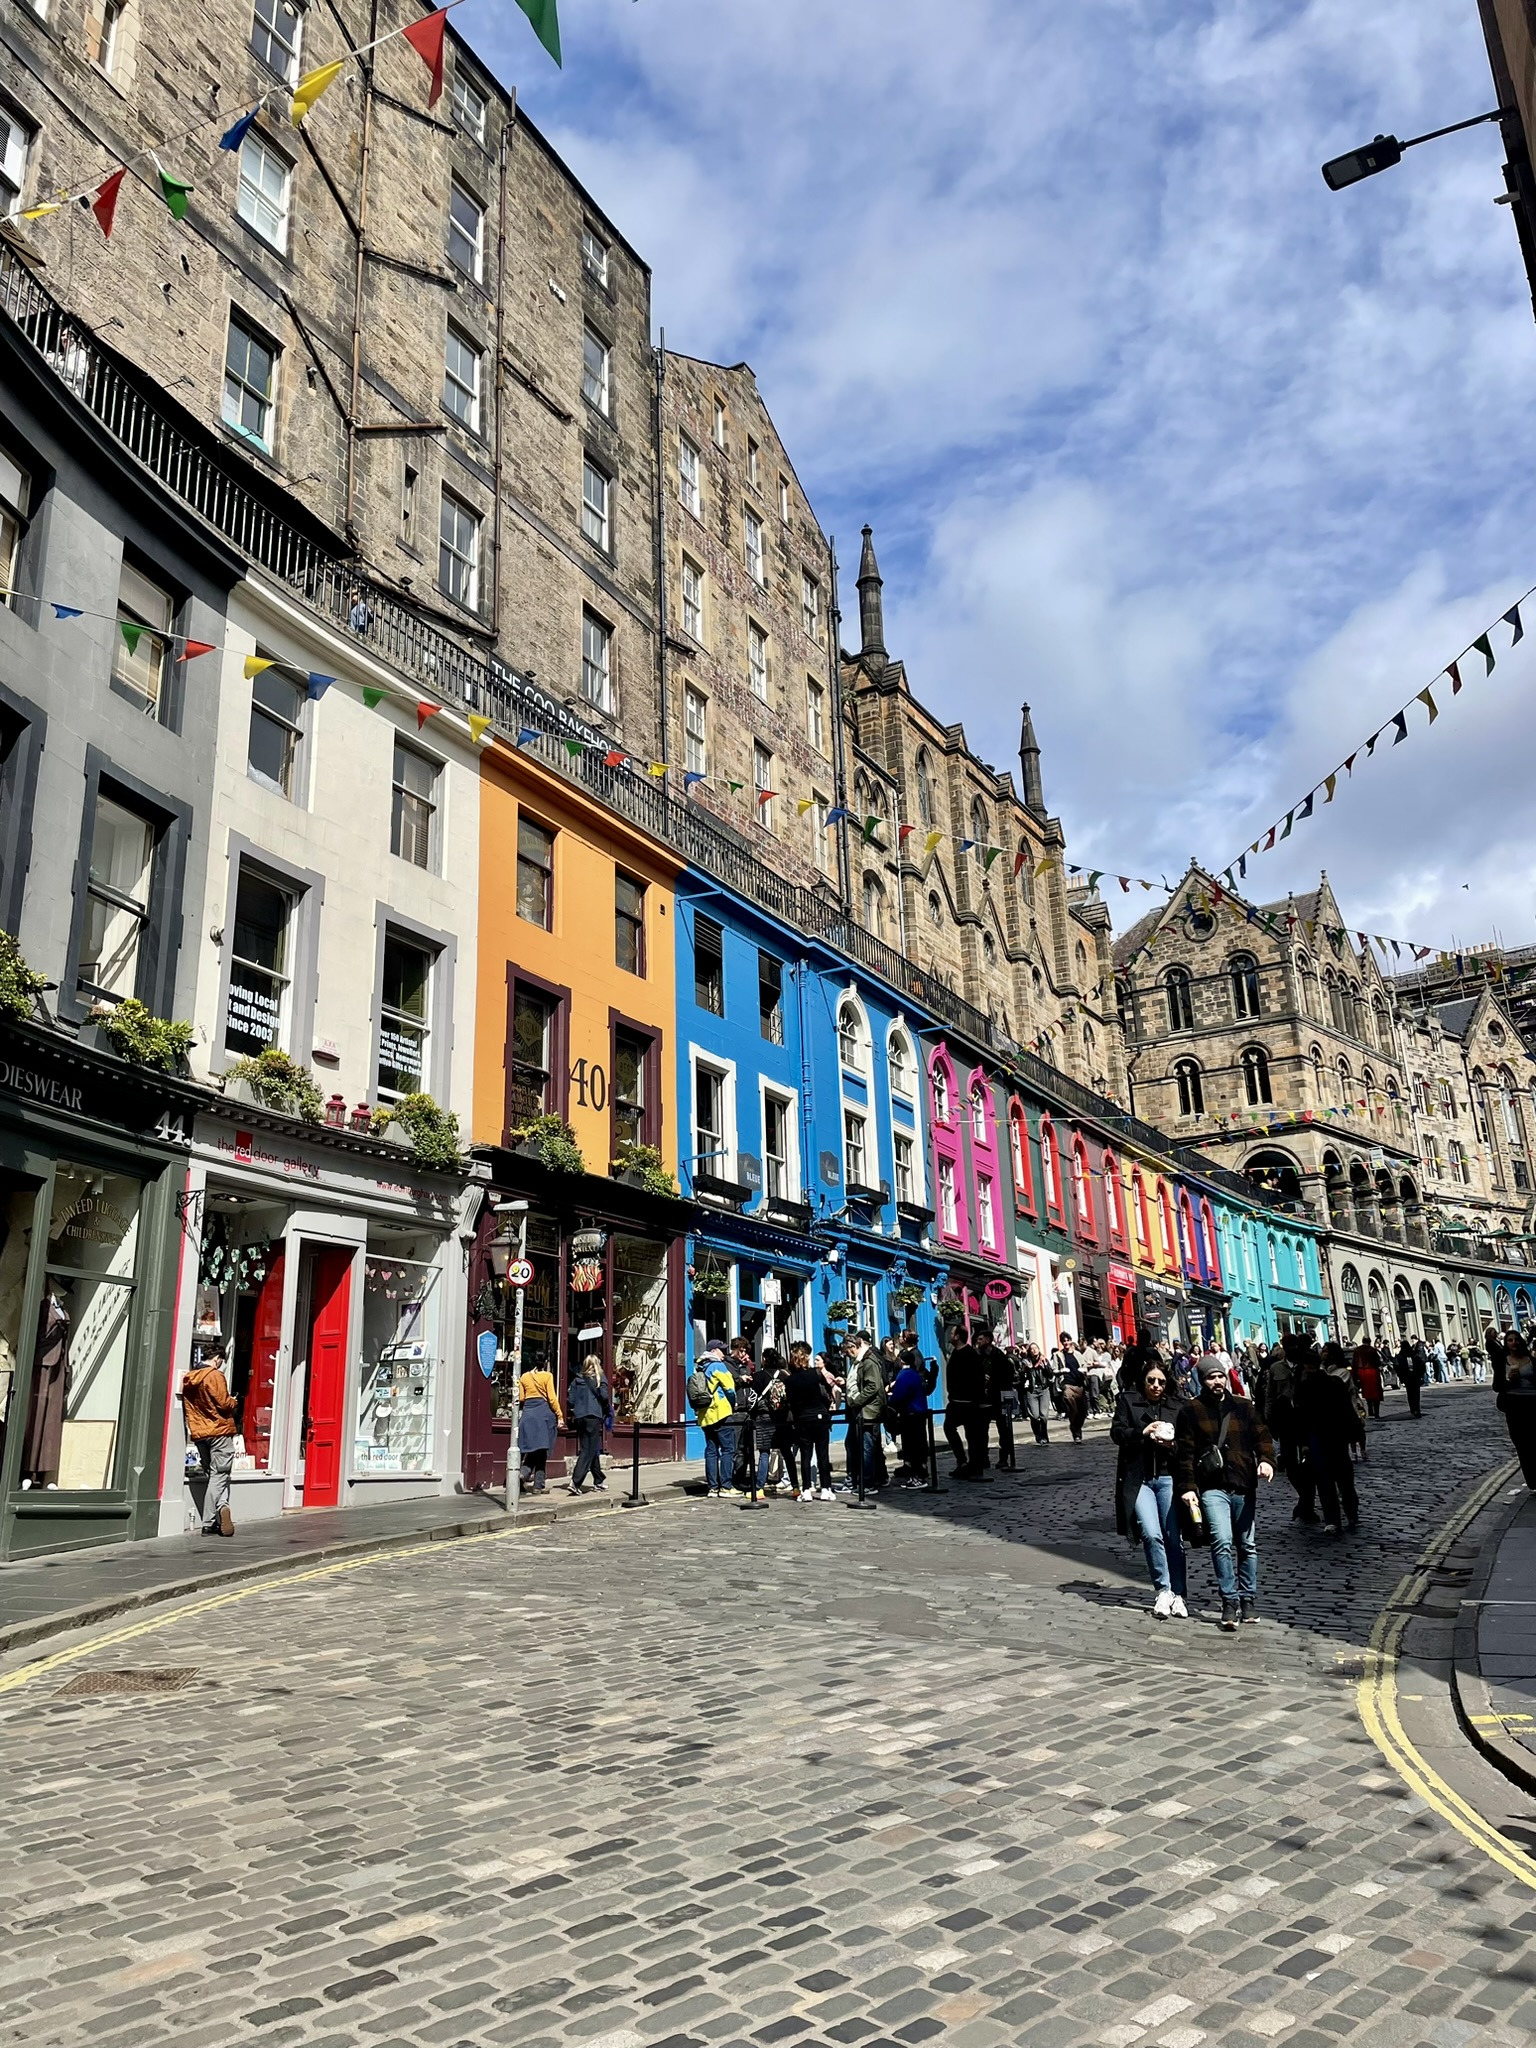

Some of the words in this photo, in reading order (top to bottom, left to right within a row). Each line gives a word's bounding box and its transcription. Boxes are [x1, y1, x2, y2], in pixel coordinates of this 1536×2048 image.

[559, 709, 632, 775] BAKEHOE
[254, 991, 278, 1012] Local
[232, 1001, 250, 1018] and
[250, 1006, 281, 1028] Design
[227, 1014, 249, 1034] ince
[249, 1022, 273, 1042] 2003
[569, 1058, 606, 1112] 40
[217, 1136, 234, 1154] the
[235, 1143, 252, 1159] red
[253, 1146, 279, 1164] door
[283, 1155, 320, 1179] gallery
[59, 1198, 93, 1223] TWEED
[511, 1265, 530, 1279] 20
[502, 1284, 550, 1307] MUEUM
[509, 1303, 541, 1321] CTEXT
[628, 1322, 654, 1337] CONEXT
[360, 1452, 371, 1461] th
